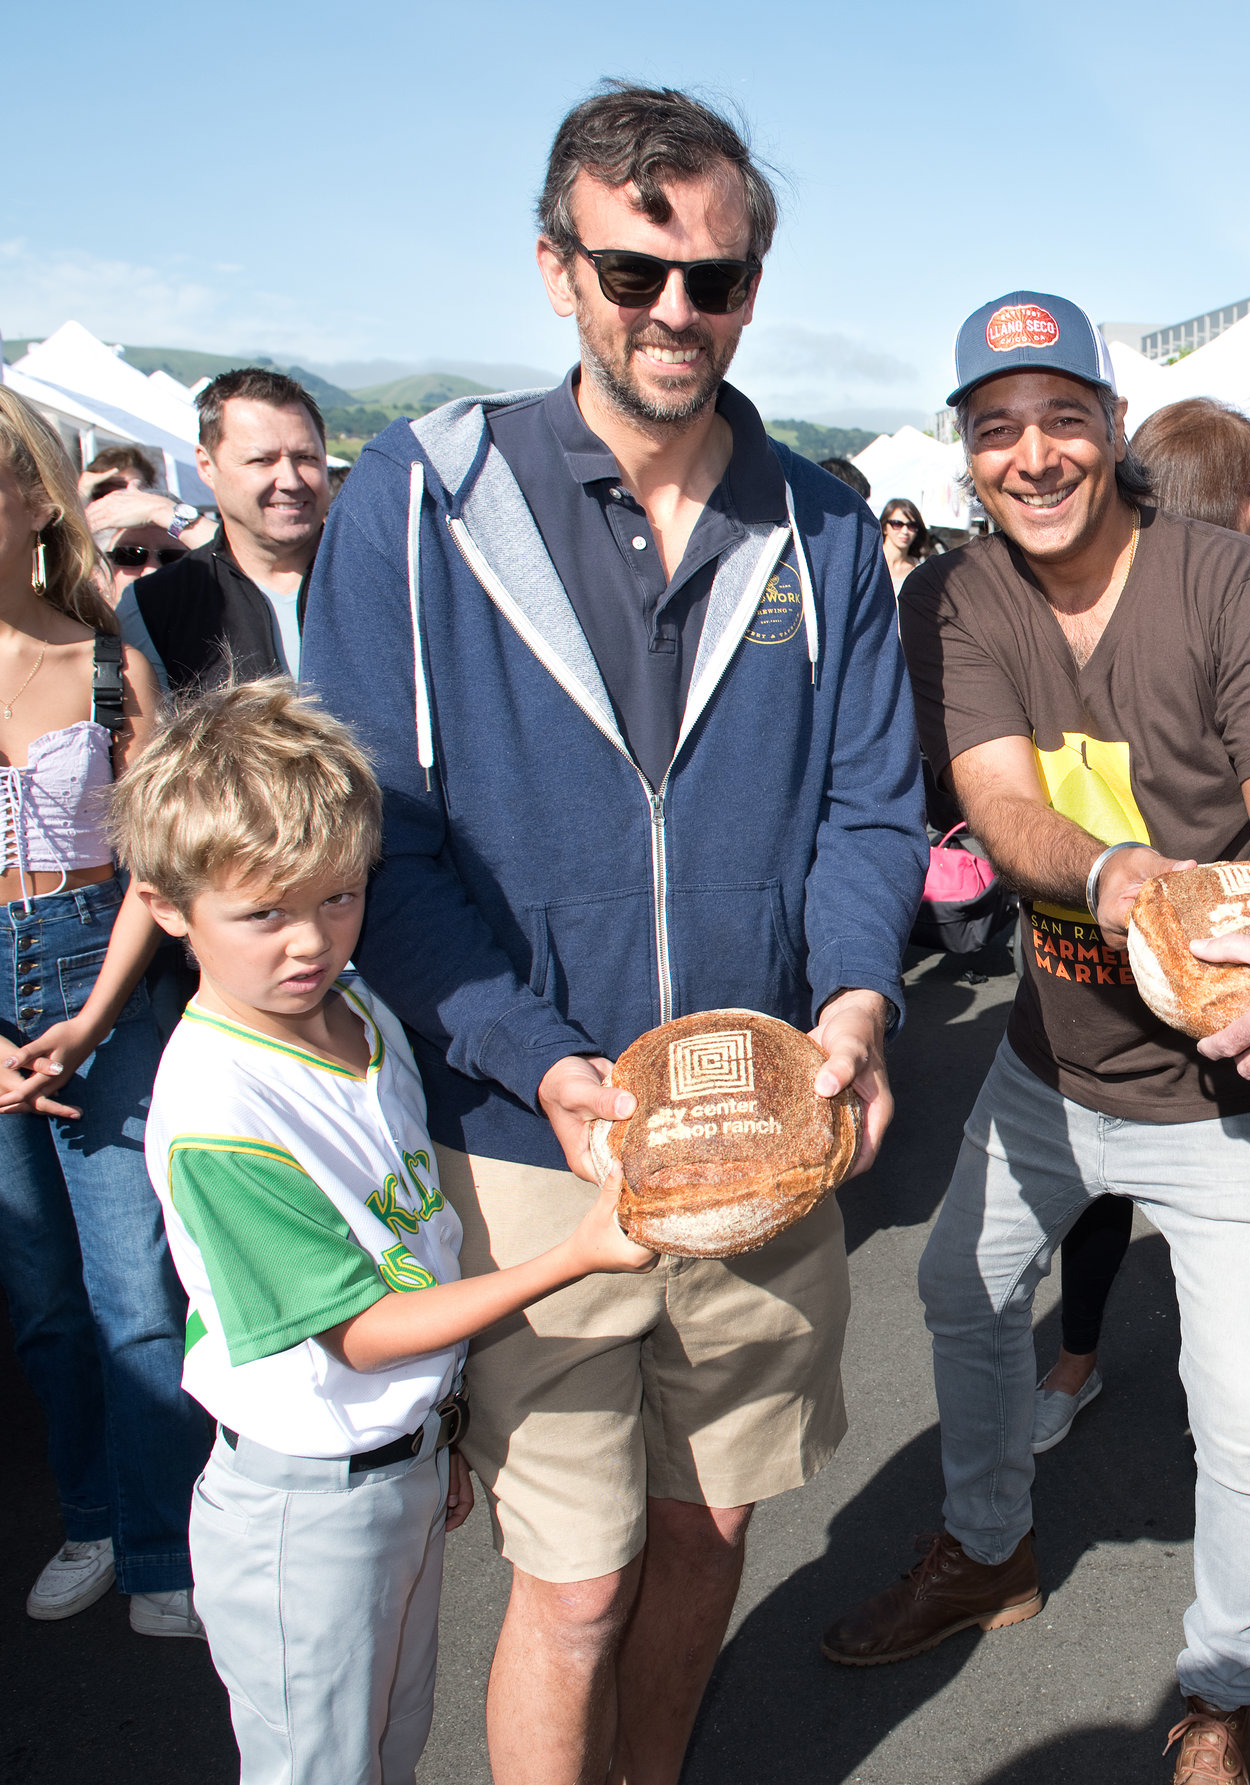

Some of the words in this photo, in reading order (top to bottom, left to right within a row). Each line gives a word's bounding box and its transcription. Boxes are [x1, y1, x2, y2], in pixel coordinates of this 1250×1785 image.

[989, 320, 1023, 340] LLANO
[1026, 320, 1055, 333] SECO
[760, 592, 801, 603] WORK
[757, 608, 788, 616] REWING
[1031, 914, 1062, 936] SAN
[1074, 926, 1099, 941] RA
[1035, 949, 1136, 985] MARKE
[690, 1099, 758, 1117] center
[722, 1116, 782, 1135] ranch
[378, 1241, 439, 1293] 5
